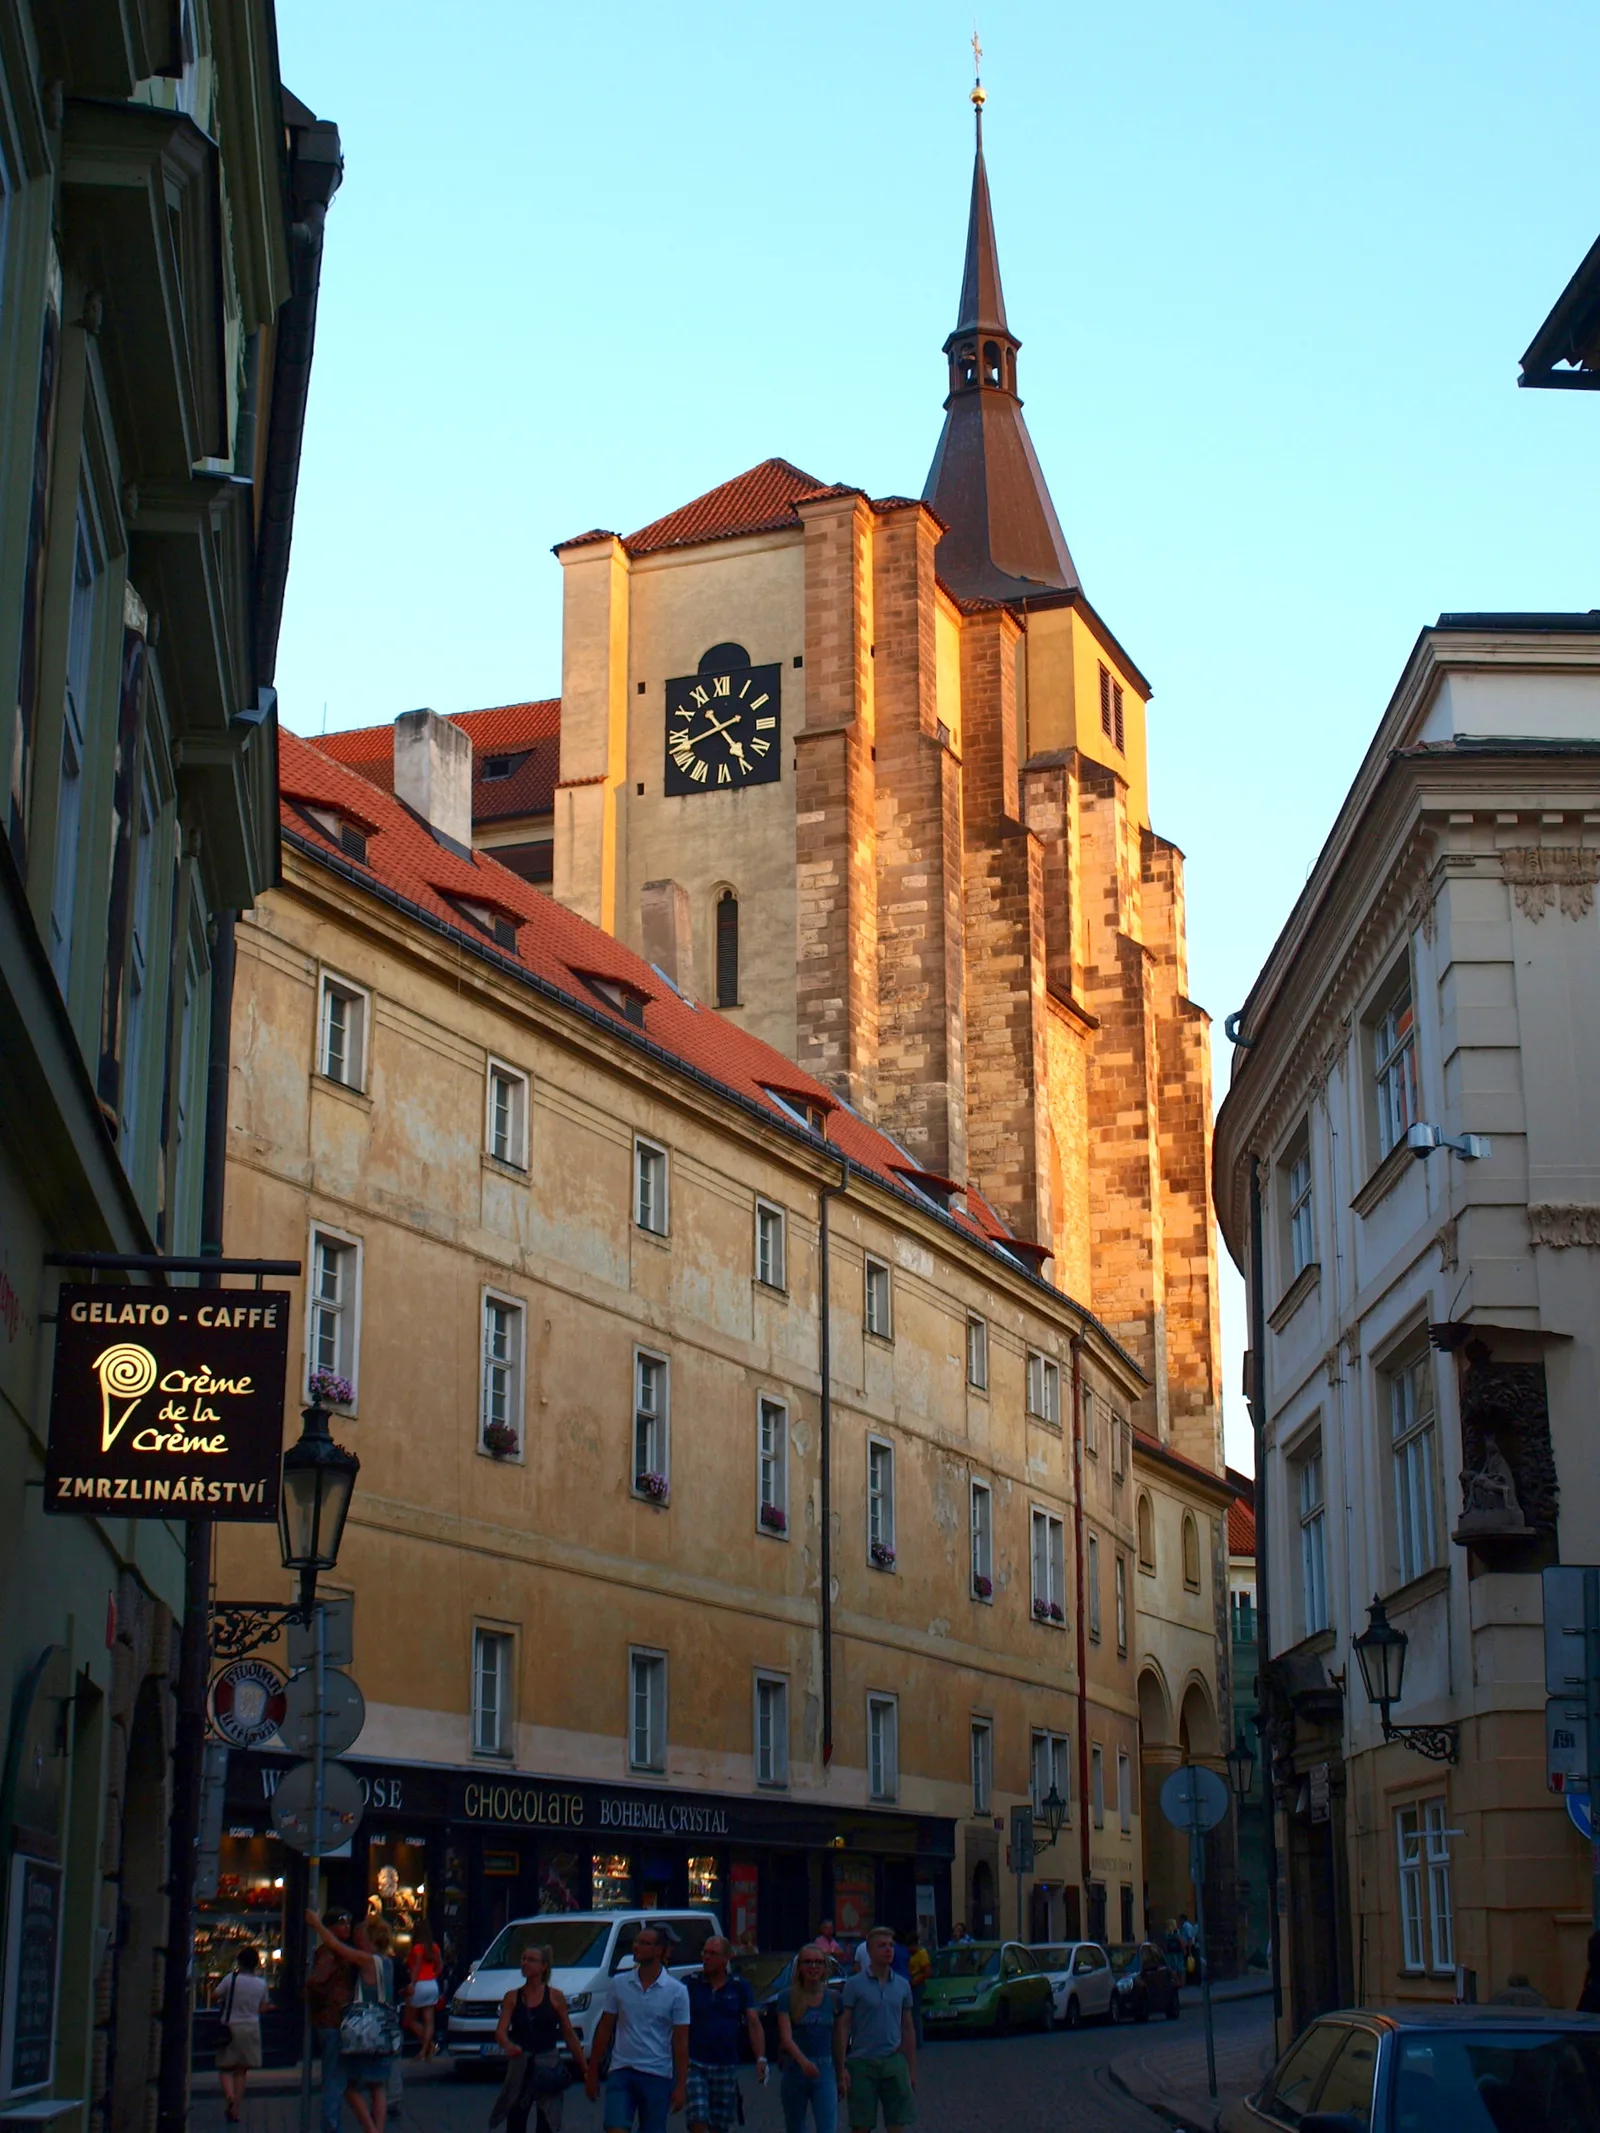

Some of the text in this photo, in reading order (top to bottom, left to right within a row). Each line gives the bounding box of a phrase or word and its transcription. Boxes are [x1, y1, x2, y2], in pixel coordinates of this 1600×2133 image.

[689, 684, 710, 708] XI
[712, 675, 731, 698] XII
[738, 679, 752, 699] I
[674, 704, 696, 722] X
[750, 693, 770, 711] II
[755, 716, 776, 731] III
[750, 737, 771, 757] IV
[689, 759, 709, 783] VII
[717, 763, 732, 784] VI
[738, 757, 754, 775] V
[70, 1302, 169, 1325] GELATO
[197, 1304, 278, 1329] CAFFÉ
[159, 1364, 255, 1395] Crème
[158, 1397, 221, 1422] de la
[132, 1423, 229, 1453] Crème
[57, 1475, 268, 1503] ZMRZLINÁŘSTVÍ
[600, 1799, 729, 1834] BOHEMIA CRYSTAL
